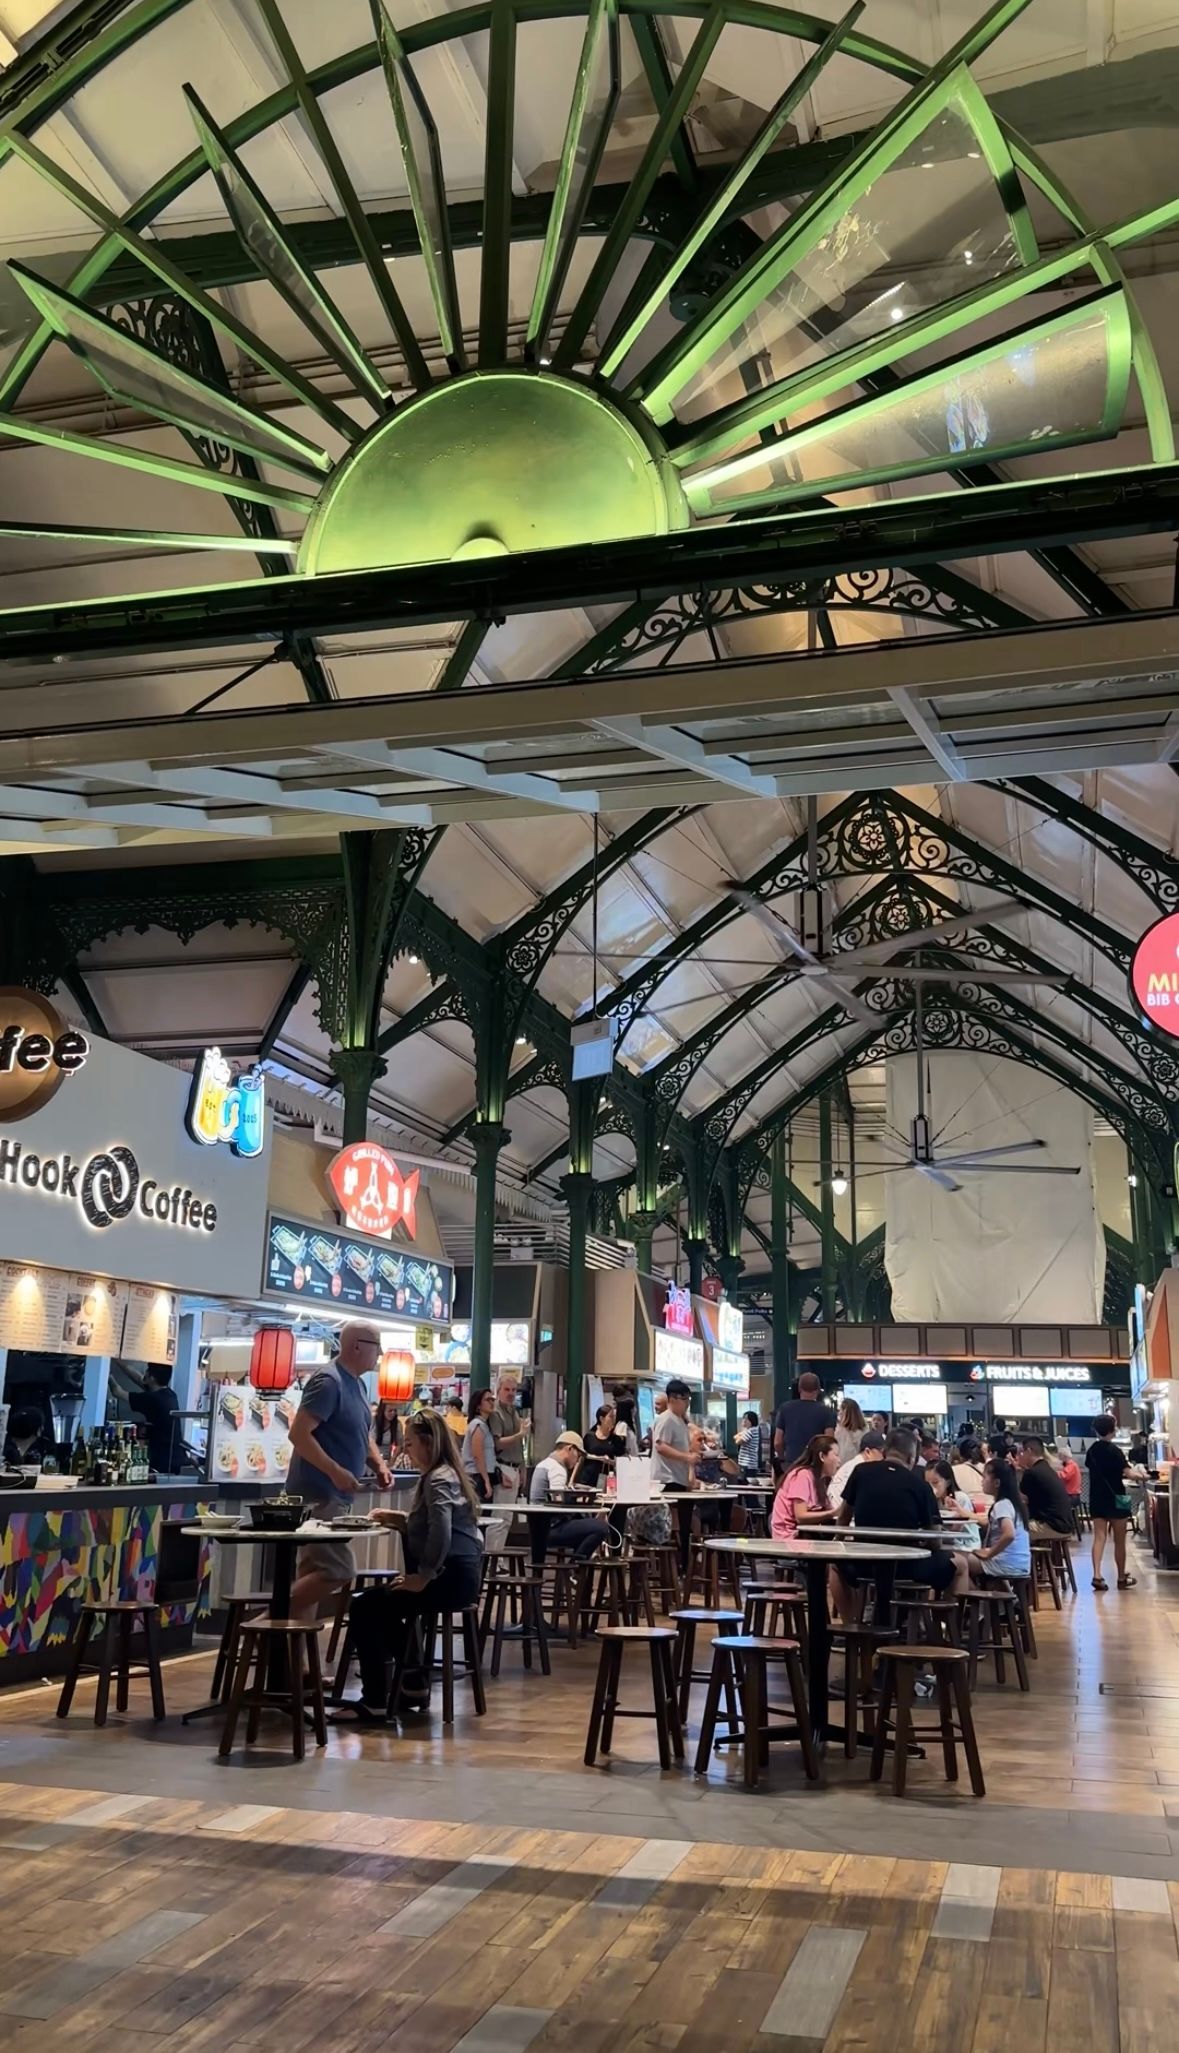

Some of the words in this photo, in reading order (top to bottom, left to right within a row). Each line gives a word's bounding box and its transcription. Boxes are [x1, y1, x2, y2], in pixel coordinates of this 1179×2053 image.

[1147, 993, 1170, 1006] BIB
[0, 1138, 80, 1198] Hook
[139, 1179, 218, 1233] Coffee
[708, 1285, 715, 1296] 3
[878, 1364, 940, 1378] DESSERTS
[986, 1365, 1032, 1380] FRUITS
[1032, 1367, 1044, 1380] &
[1043, 1367, 1091, 1381] JUICES
